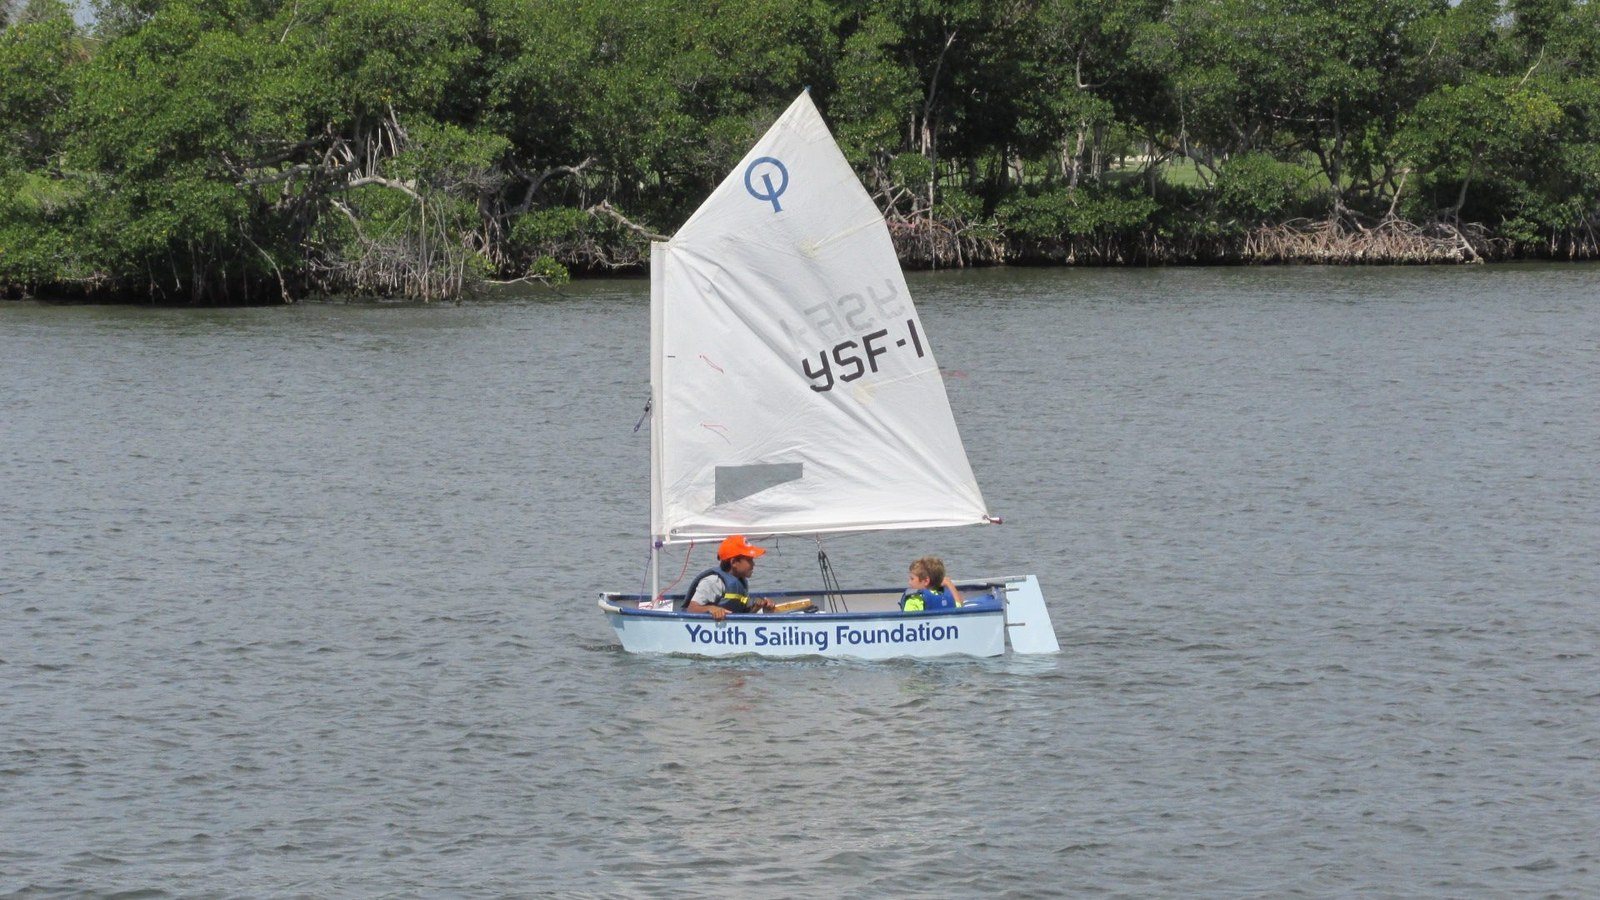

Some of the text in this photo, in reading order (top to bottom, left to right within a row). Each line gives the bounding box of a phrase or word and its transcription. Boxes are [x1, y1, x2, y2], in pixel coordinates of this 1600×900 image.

[685, 621, 959, 652] Youth Sailing Foundation
